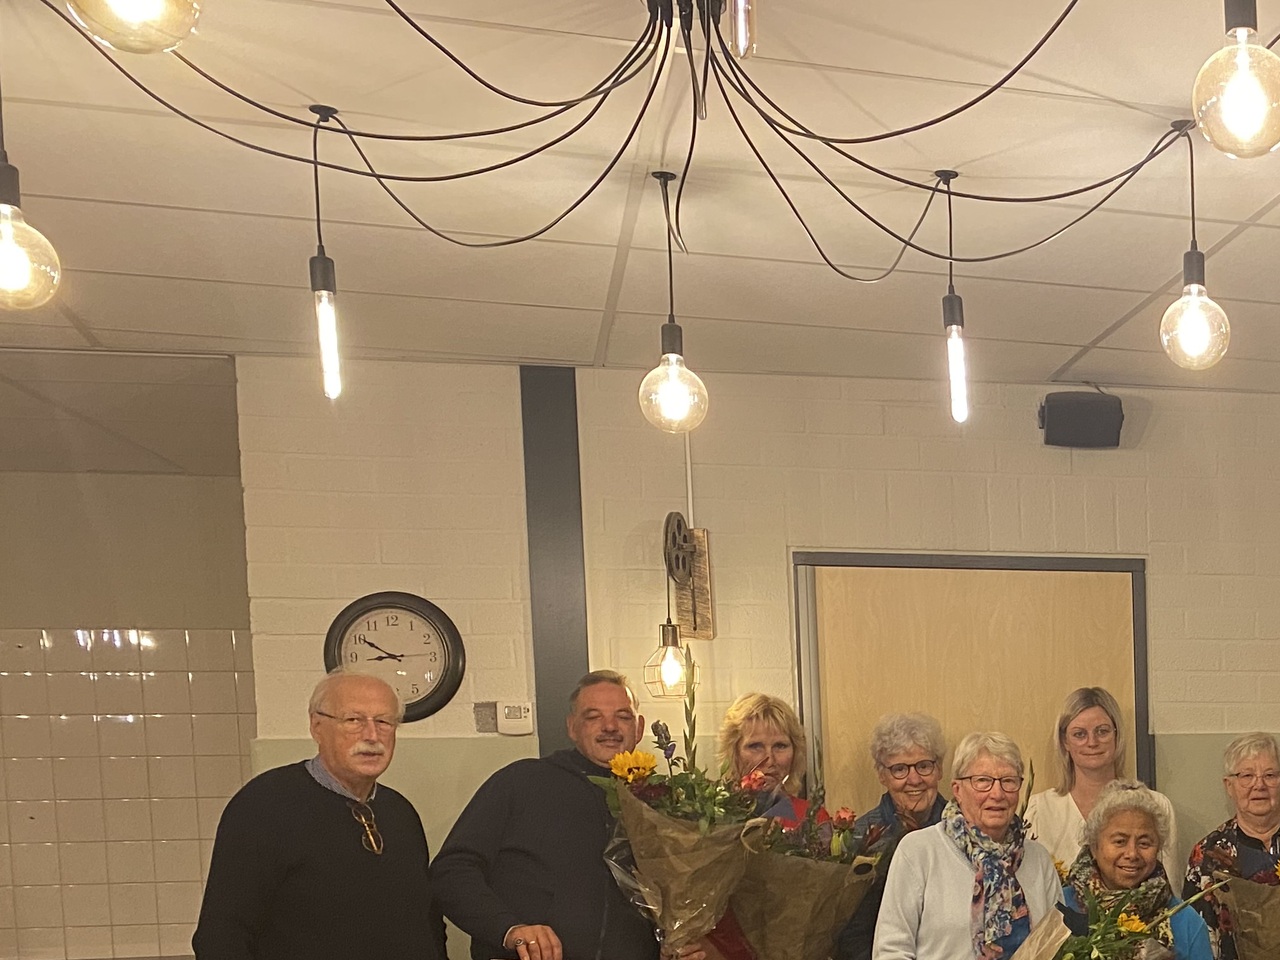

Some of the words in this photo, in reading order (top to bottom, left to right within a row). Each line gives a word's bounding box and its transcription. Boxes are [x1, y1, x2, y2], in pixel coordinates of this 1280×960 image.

[366, 620, 378, 631] 11
[385, 615, 398, 626] 12
[409, 620, 414, 631] 1
[353, 634, 366, 645] 10
[423, 634, 431, 644] 2
[350, 652, 358, 662] 9
[429, 652, 437, 662] 3
[411, 684, 419, 694] 5
